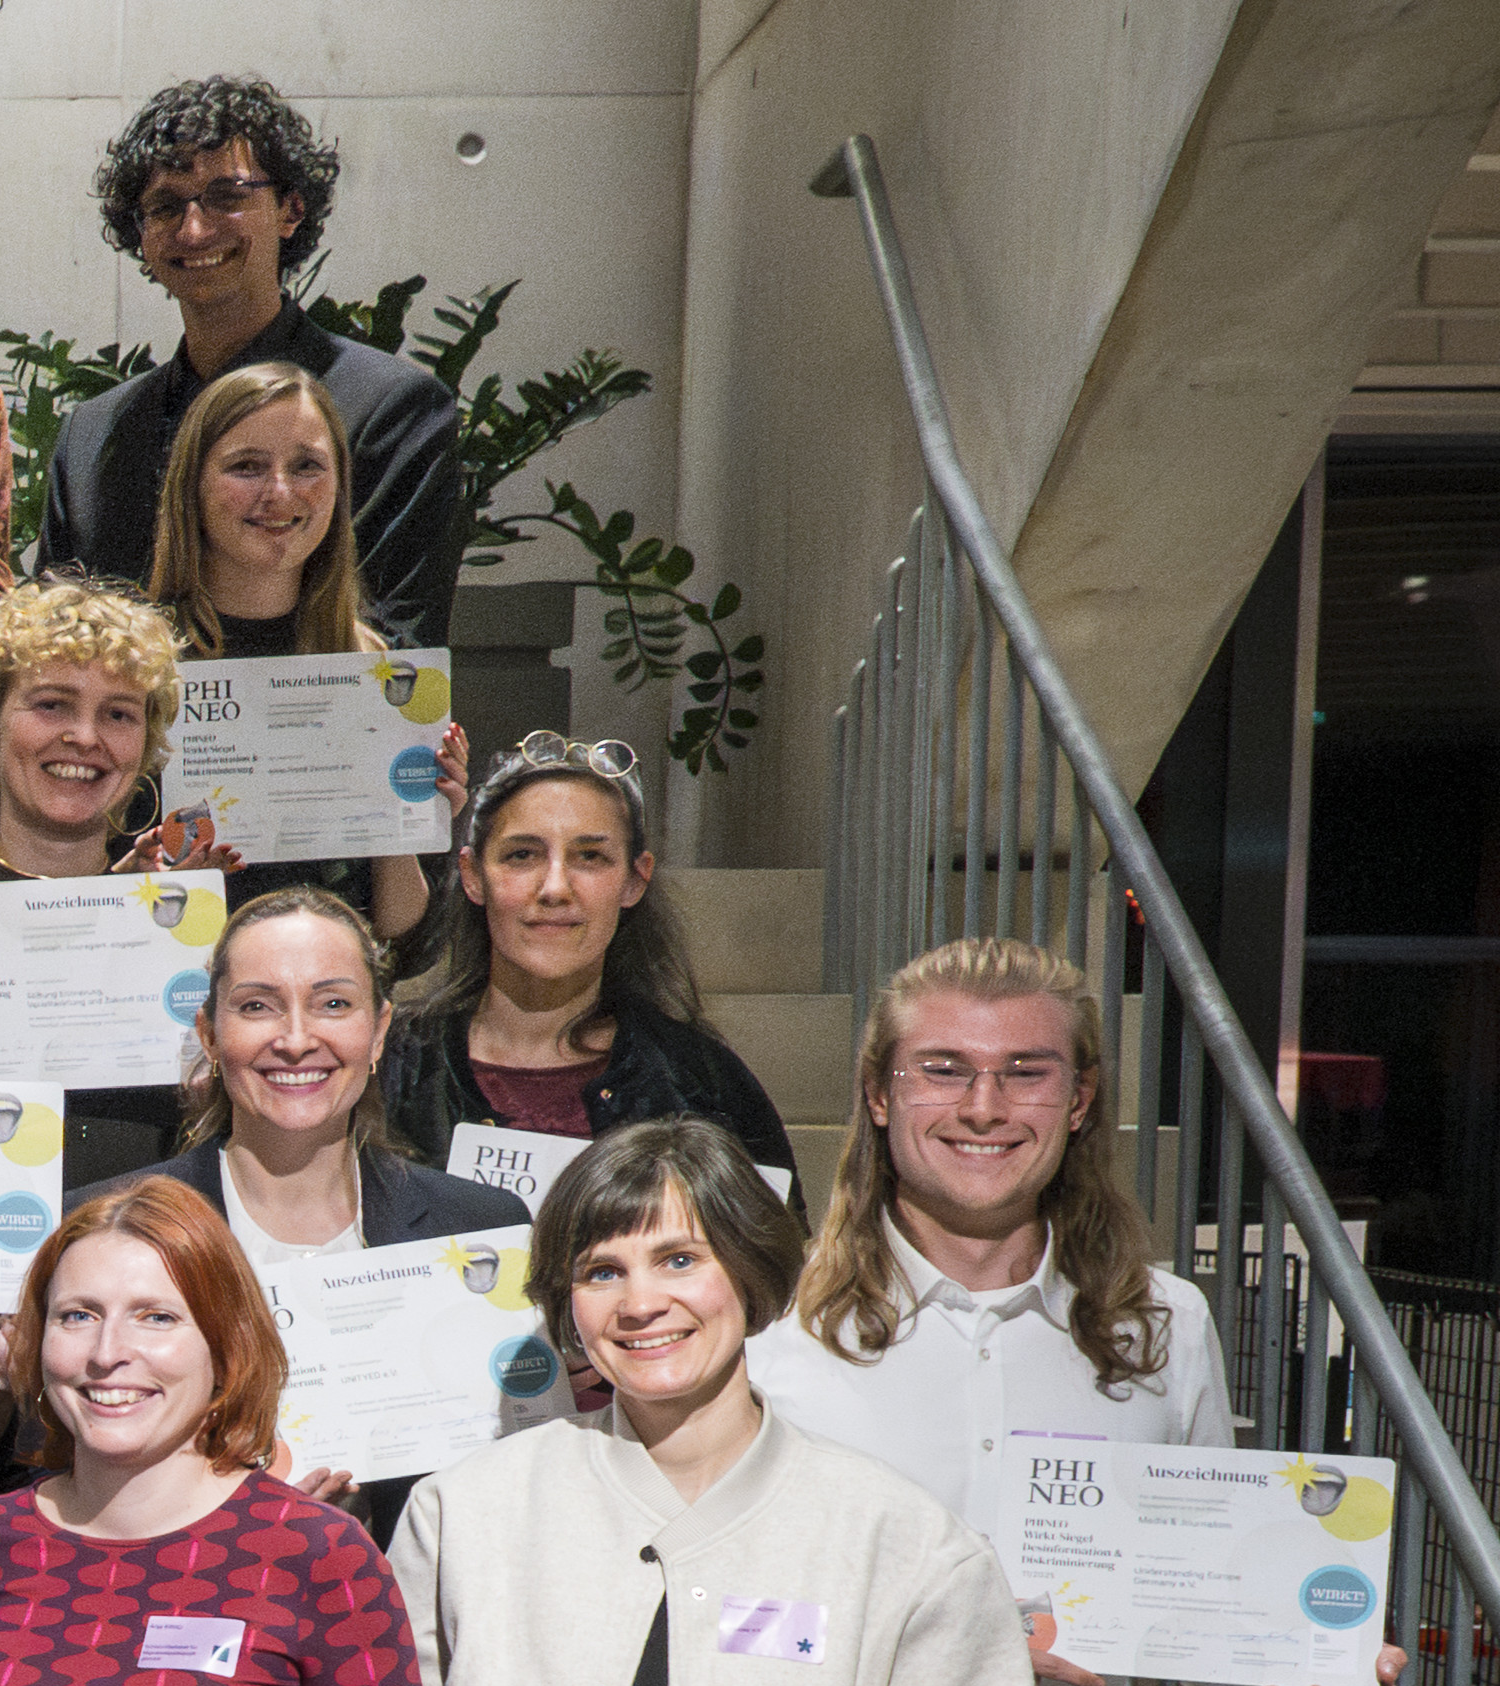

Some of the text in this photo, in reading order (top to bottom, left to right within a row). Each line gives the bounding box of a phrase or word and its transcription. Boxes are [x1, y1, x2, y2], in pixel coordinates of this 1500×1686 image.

[183, 679, 231, 700] PHI
[183, 701, 240, 722] NEO
[474, 1145, 531, 1171] PHI
[1029, 1457, 1094, 1482] PHI
[1144, 1465, 1267, 1486] Auszeichnung
[1028, 1482, 1103, 1506] NEO
[1310, 1588, 1365, 1604] WIRKT!
